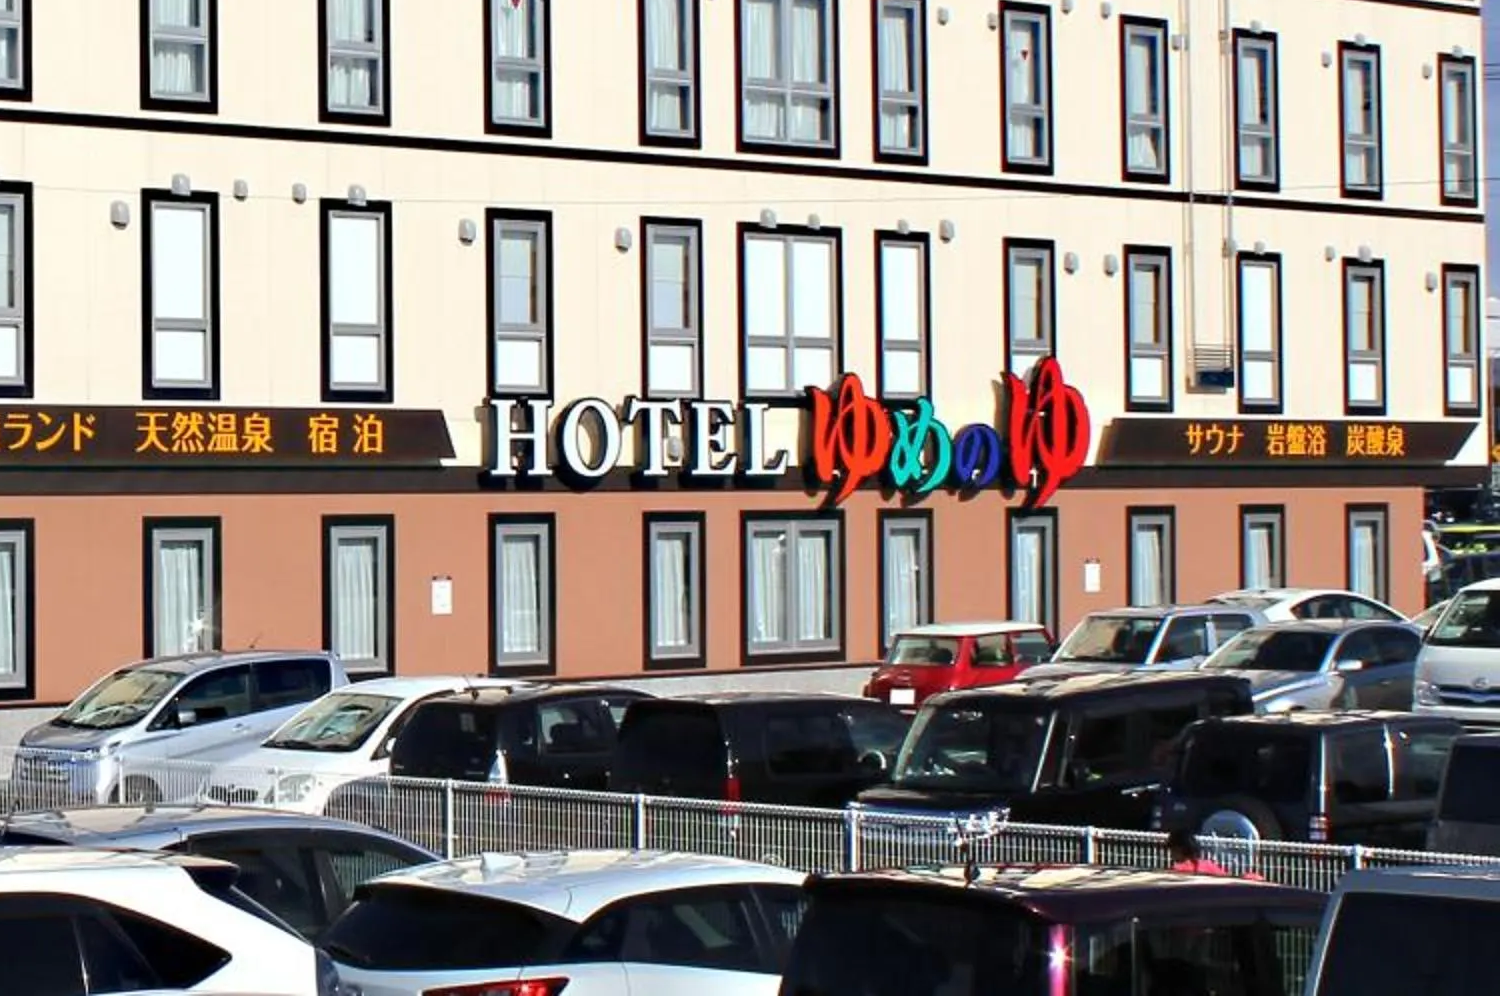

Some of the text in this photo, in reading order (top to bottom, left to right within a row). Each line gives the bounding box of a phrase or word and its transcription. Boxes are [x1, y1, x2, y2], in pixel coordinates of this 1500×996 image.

[135, 411, 275, 454] 天然温泉
[490, 356, 1091, 508] HOTEL ゆめのゆ
[1185, 422, 1405, 456] サウナ 岩盤浴 炭酸泉
